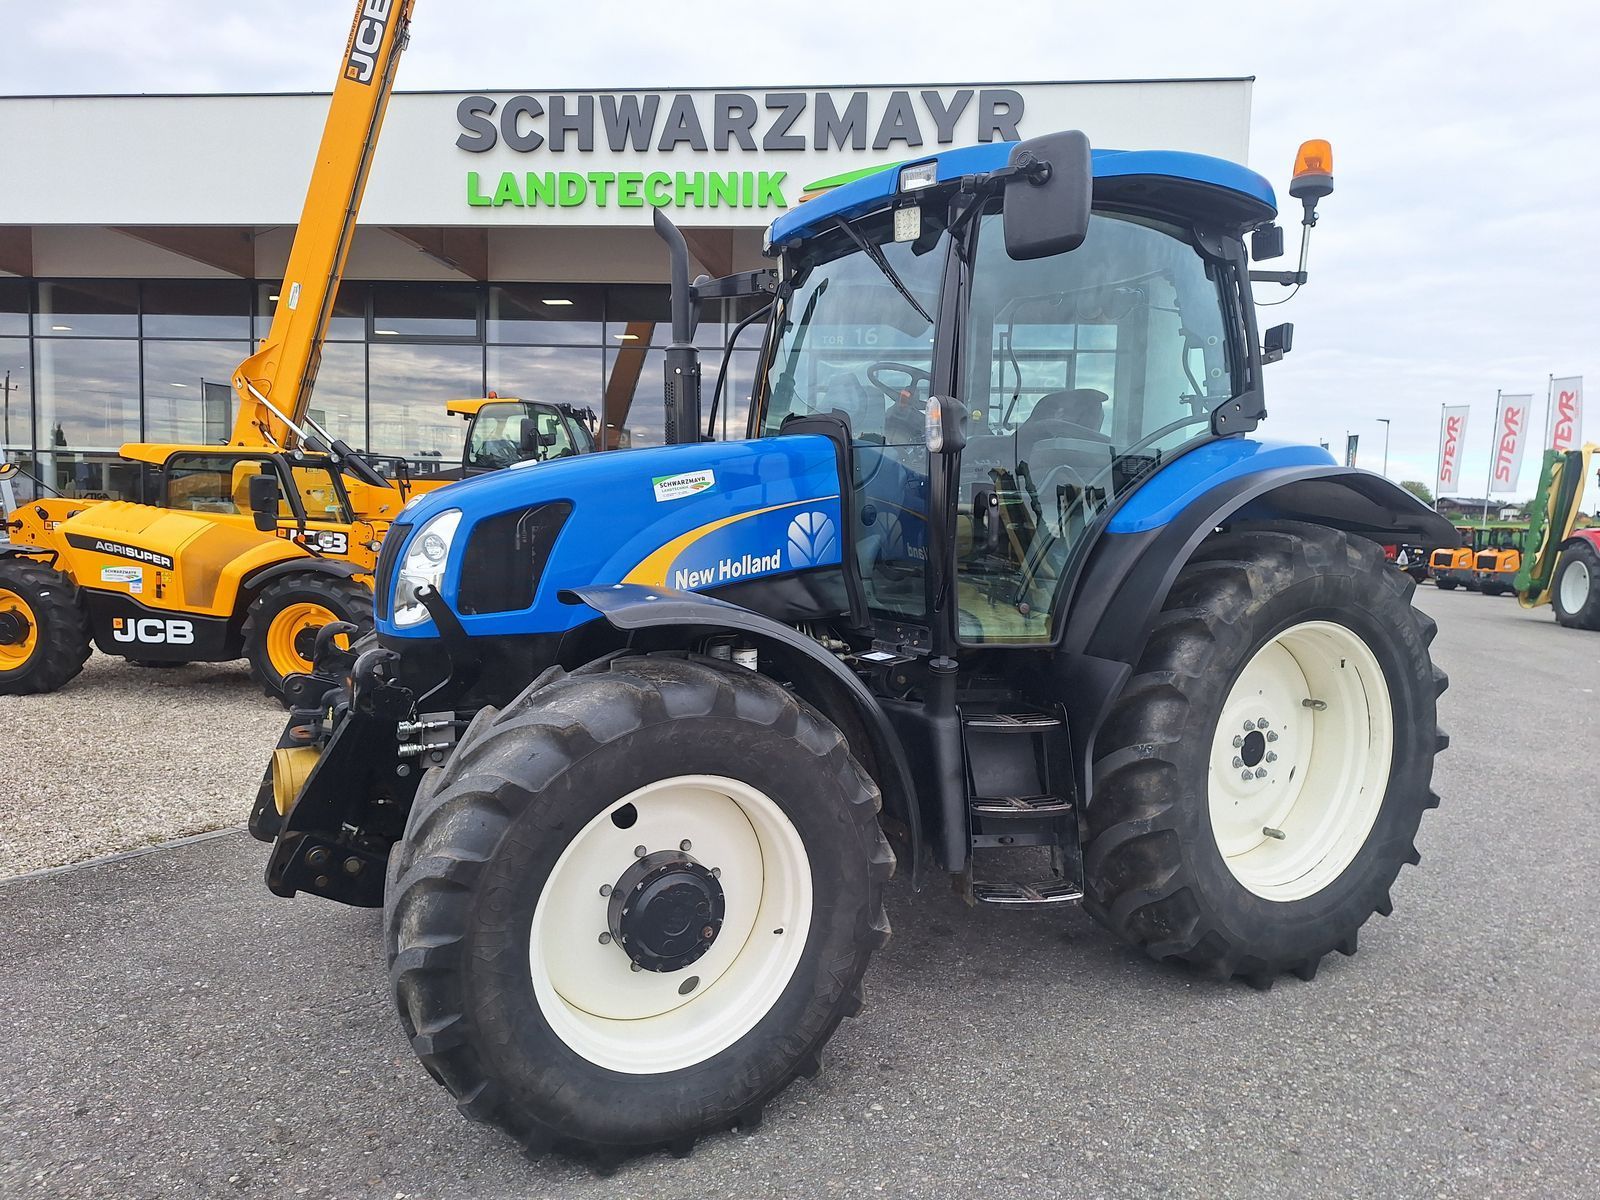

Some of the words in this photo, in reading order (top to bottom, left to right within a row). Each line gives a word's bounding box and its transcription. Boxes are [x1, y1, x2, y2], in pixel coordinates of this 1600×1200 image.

[456, 89, 1025, 153] SCHWARZMAYR
[467, 171, 788, 208] LANDTECHNIK
[855, 327, 879, 345] 16
[1440, 416, 1461, 483] STEYR
[1495, 406, 1521, 483] STEYR
[659, 476, 706, 489] SCHWARZMAYR
[95, 540, 171, 567] AGRISUPER
[675, 568, 715, 591] New
[719, 549, 781, 581] Holland
[113, 617, 195, 645] JCB
